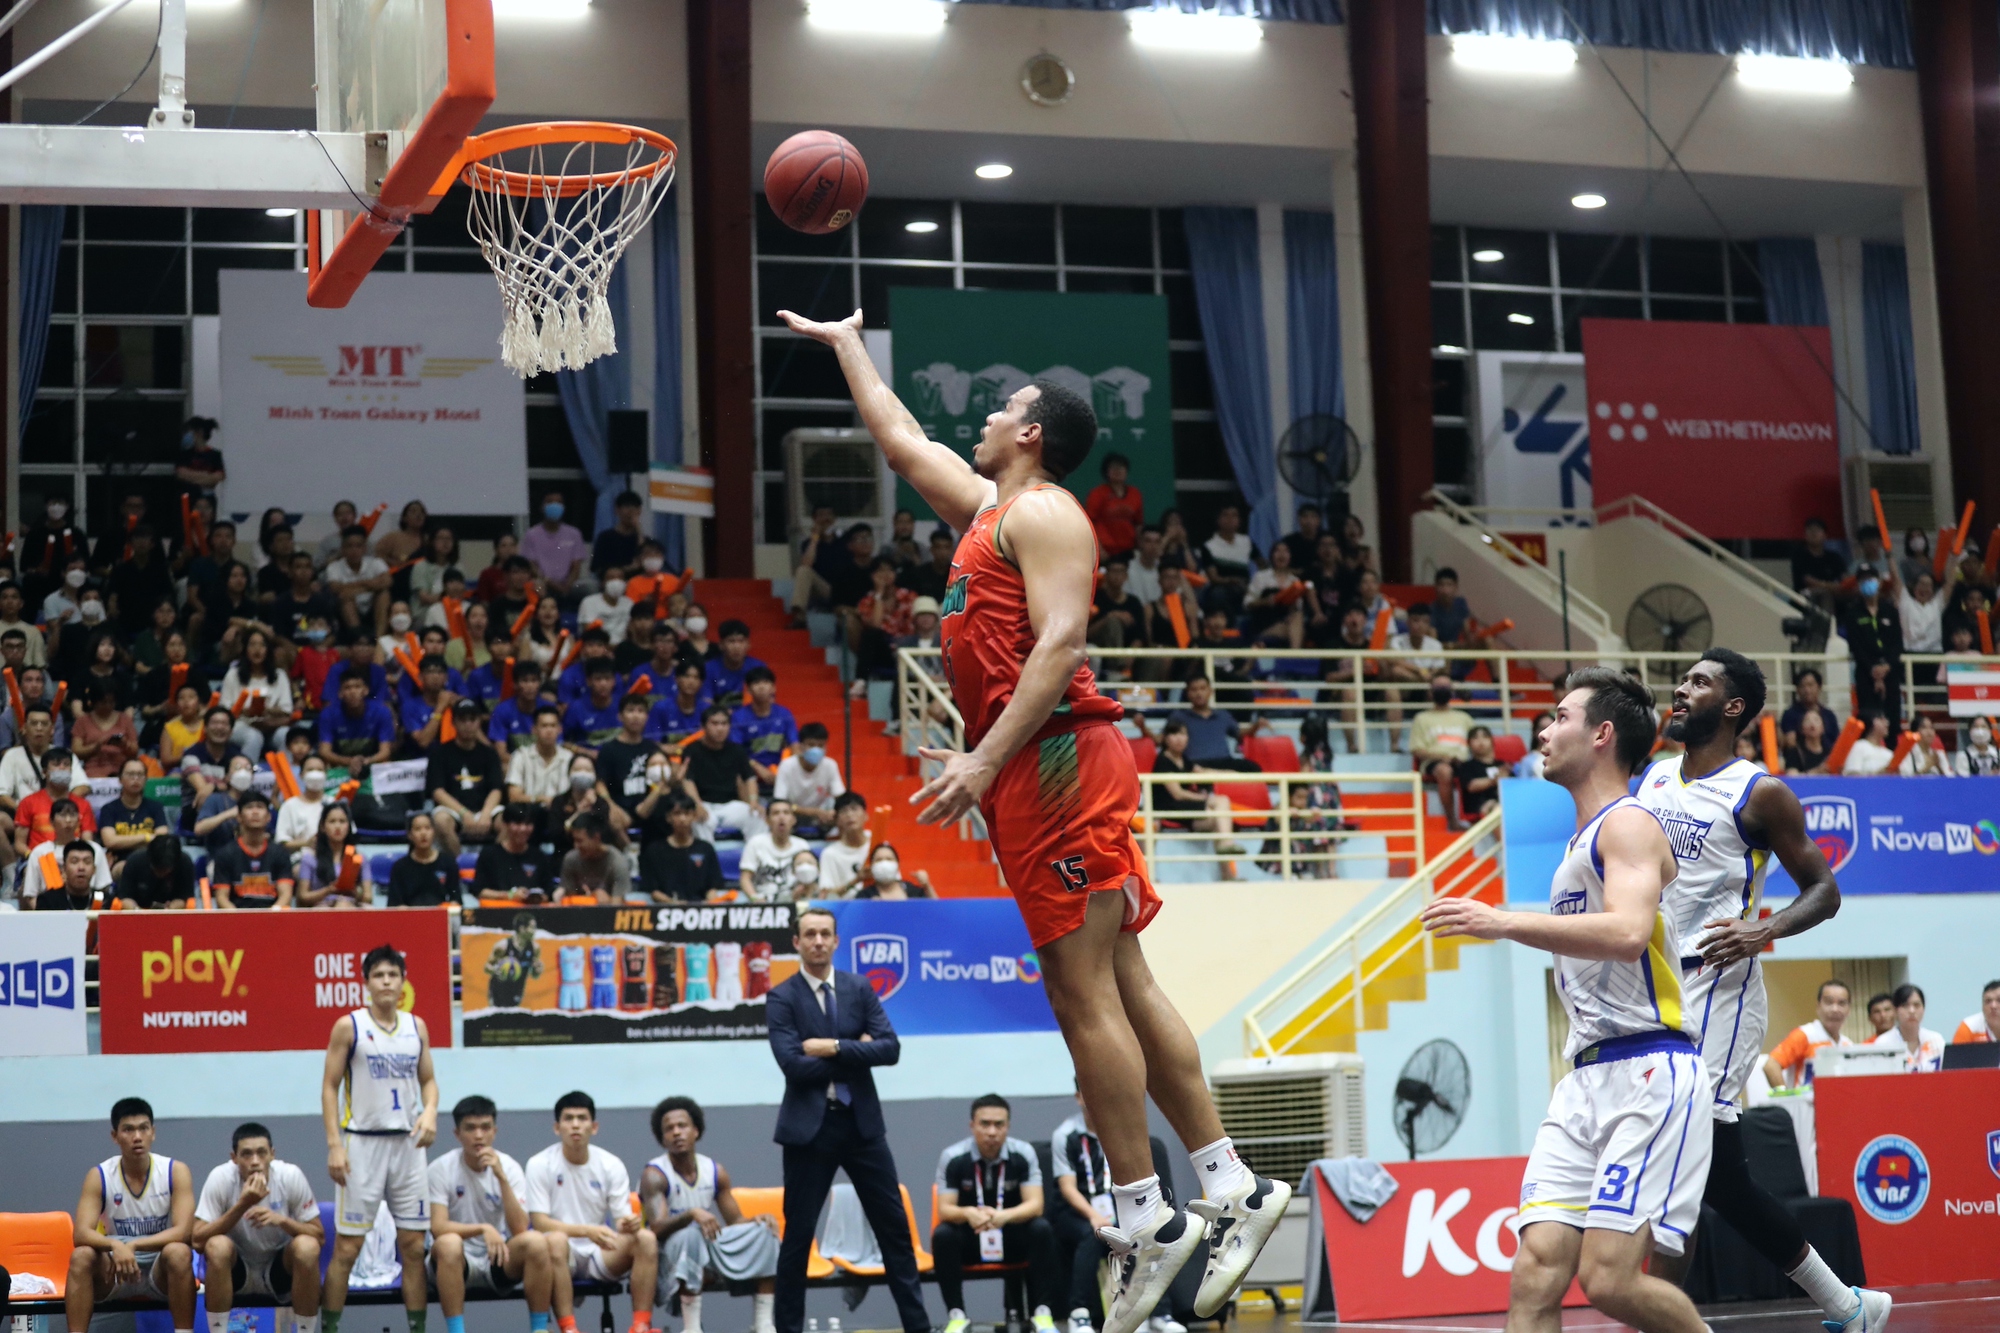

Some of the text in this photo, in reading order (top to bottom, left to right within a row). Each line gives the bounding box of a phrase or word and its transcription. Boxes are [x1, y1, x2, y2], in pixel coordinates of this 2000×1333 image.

[268, 406, 480, 424] Minh Toan Galaxy Hotel
[1662, 809, 1674, 819] CHI
[1674, 811, 1694, 822] MINH
[1805, 803, 1852, 832] VBA
[1052, 855, 1090, 893] 15
[614, 906, 791, 932] HTL SPORT WEAR
[859, 941, 903, 965] VBA
[314, 953, 356, 979] ONE
[143, 1010, 248, 1029] NUTRITION
[391, 1088, 401, 1110] 1
[1598, 1163, 1630, 1202] 3
[418, 1200, 425, 1216] 1
